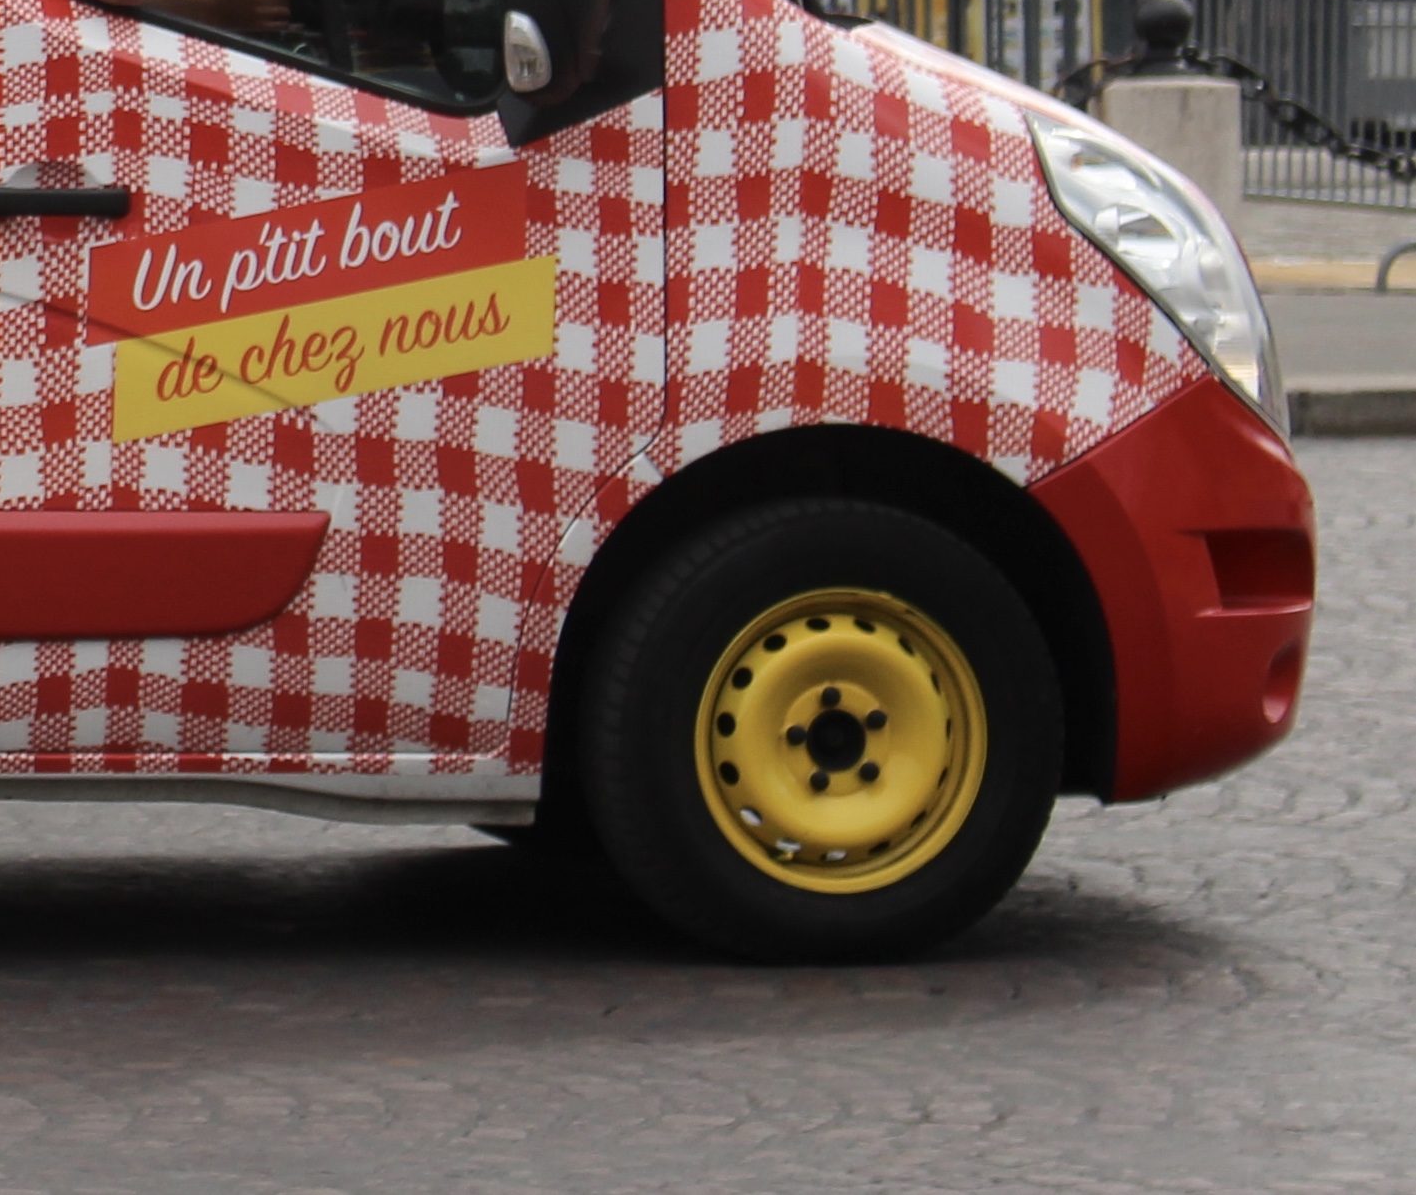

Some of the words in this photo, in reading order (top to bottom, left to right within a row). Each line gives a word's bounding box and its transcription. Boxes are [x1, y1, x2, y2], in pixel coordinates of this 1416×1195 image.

[132, 243, 212, 311] Un
[220, 221, 327, 313] p'tit
[339, 190, 461, 270] bout
[157, 337, 223, 402] de
[240, 314, 364, 393] chez
[379, 293, 510, 358] nous
